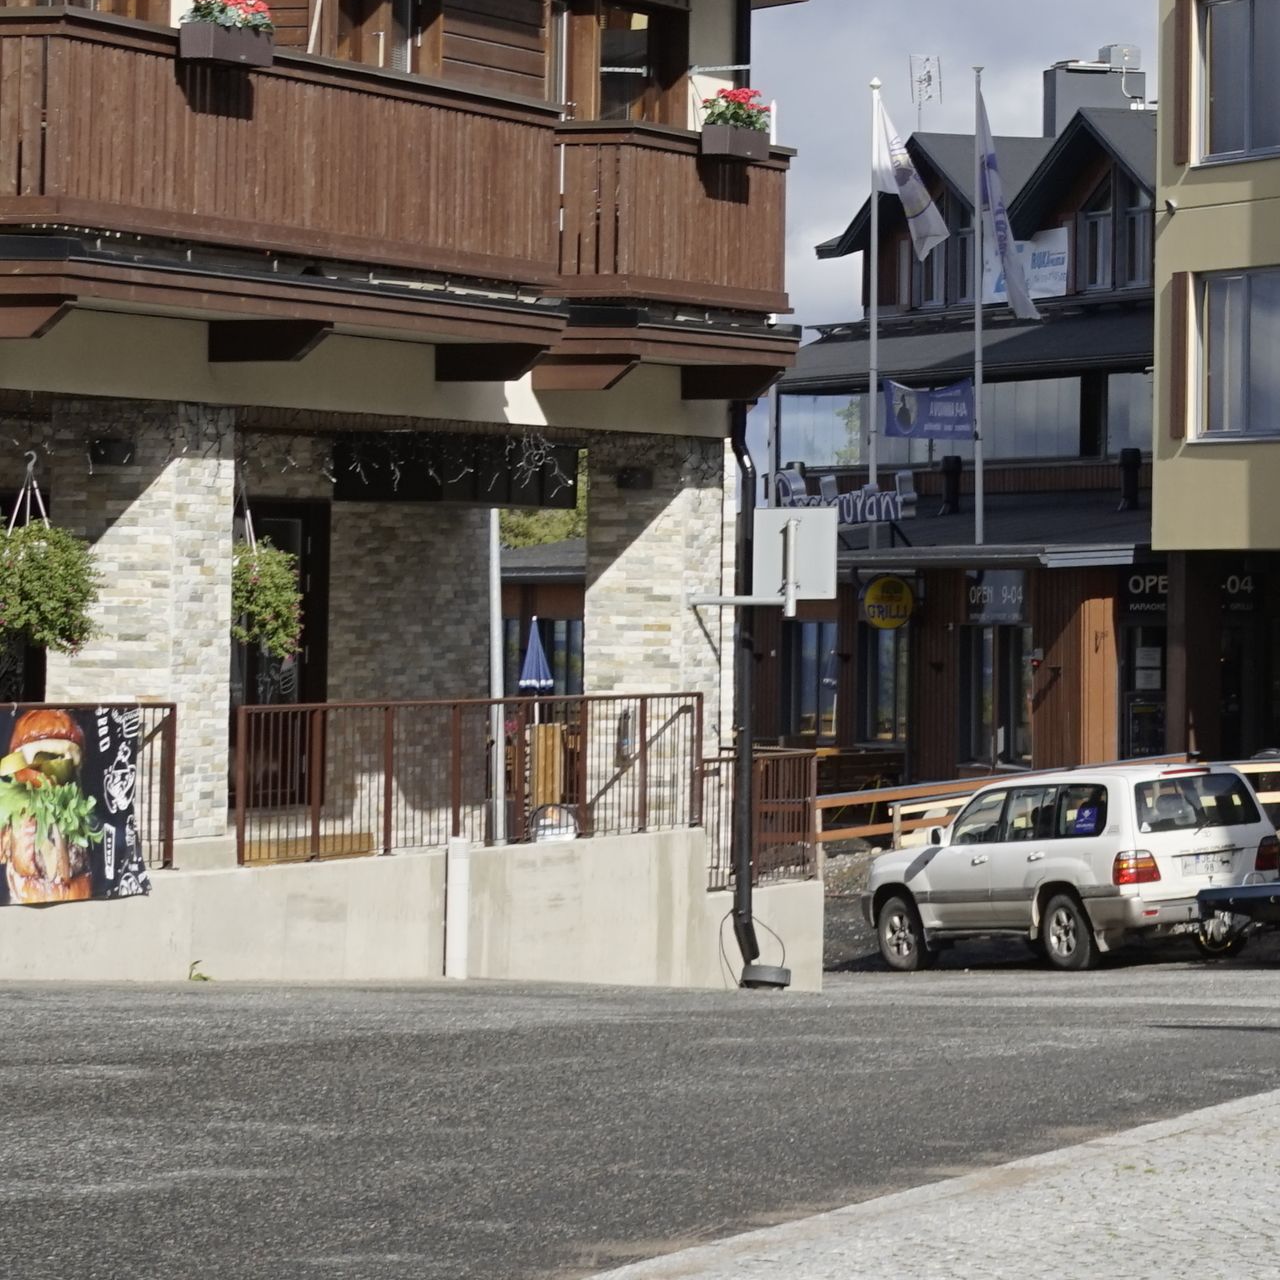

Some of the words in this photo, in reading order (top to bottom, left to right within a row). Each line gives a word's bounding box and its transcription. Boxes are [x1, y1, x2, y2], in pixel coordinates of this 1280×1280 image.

[1128, 574, 1169, 595] OPE
[1220, 574, 1255, 595] -04
[969, 585, 993, 605] OPEN
